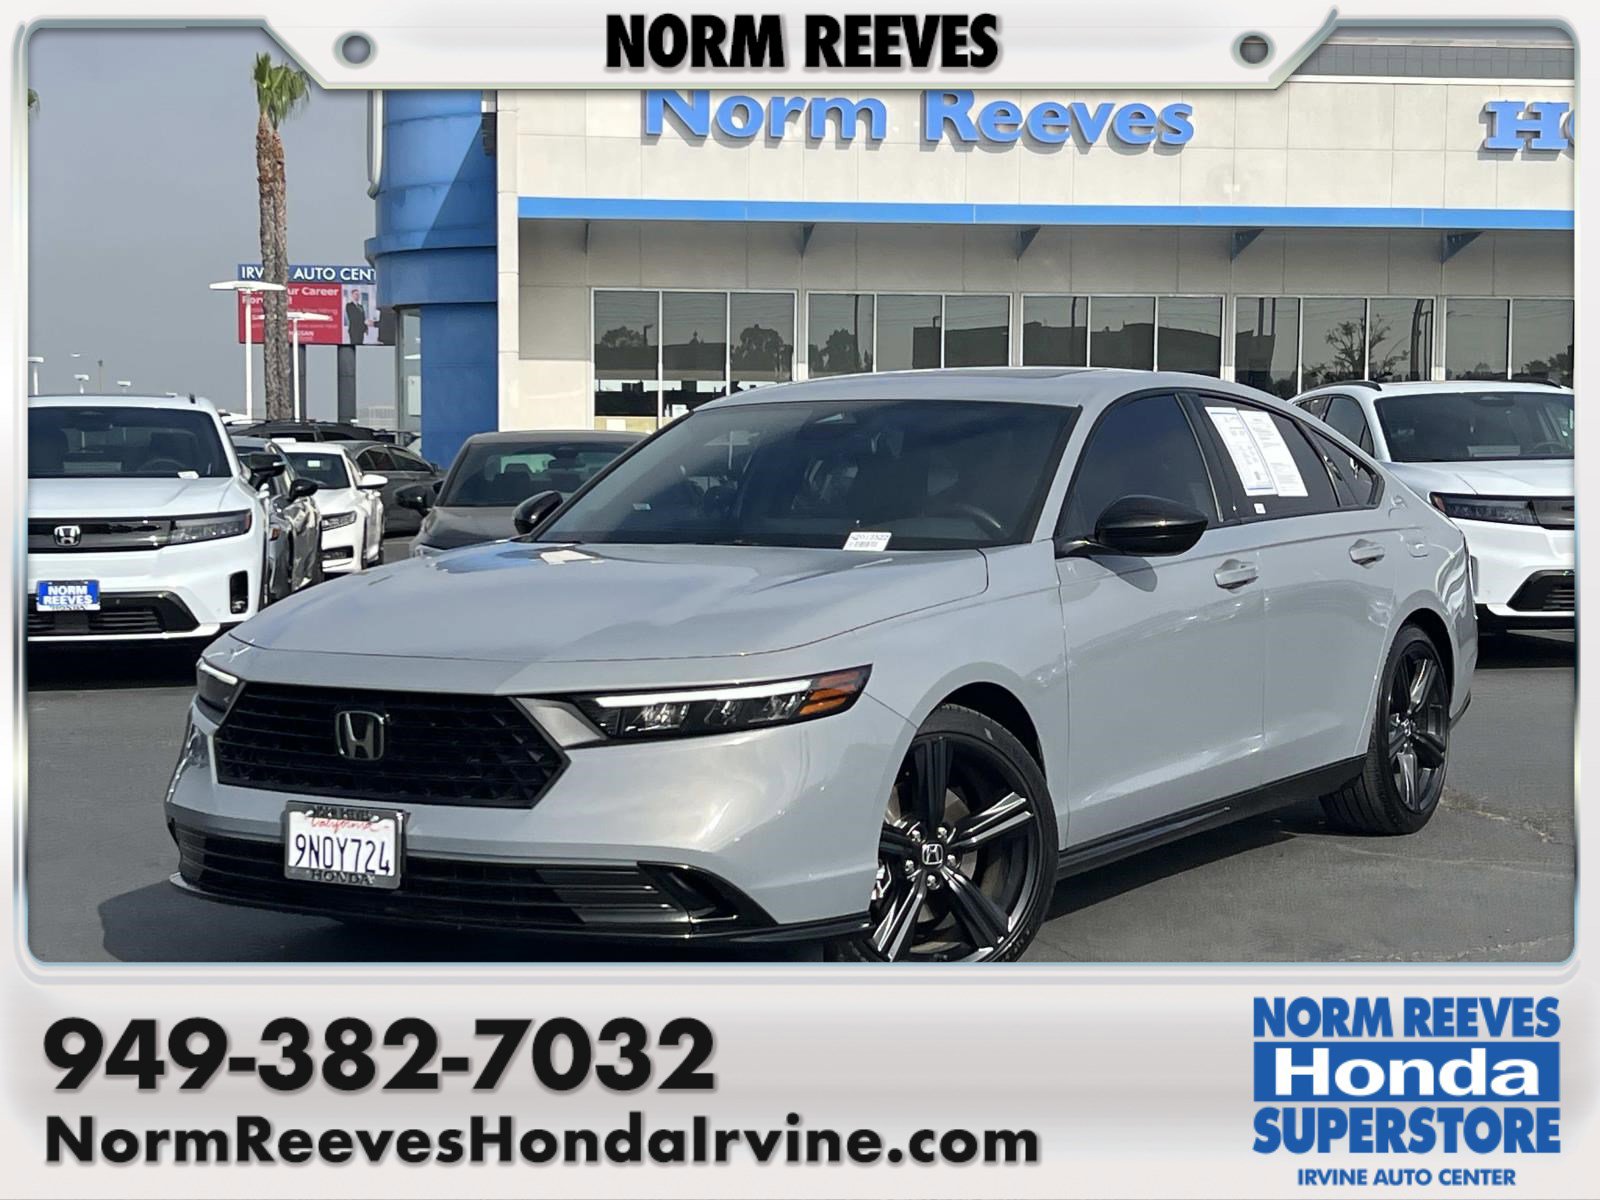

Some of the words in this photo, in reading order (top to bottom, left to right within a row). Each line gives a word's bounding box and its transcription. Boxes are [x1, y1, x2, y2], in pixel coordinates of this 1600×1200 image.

[647, 91, 886, 140] Norm
[927, 91, 1193, 145] Reeves
[1485, 101, 1574, 150] H
[293, 267, 336, 281] AUTO
[301, 287, 339, 296] Career
[47, 585, 88, 596] NORM
[43, 595, 93, 605] REEVES
[312, 869, 374, 885] HONDA
